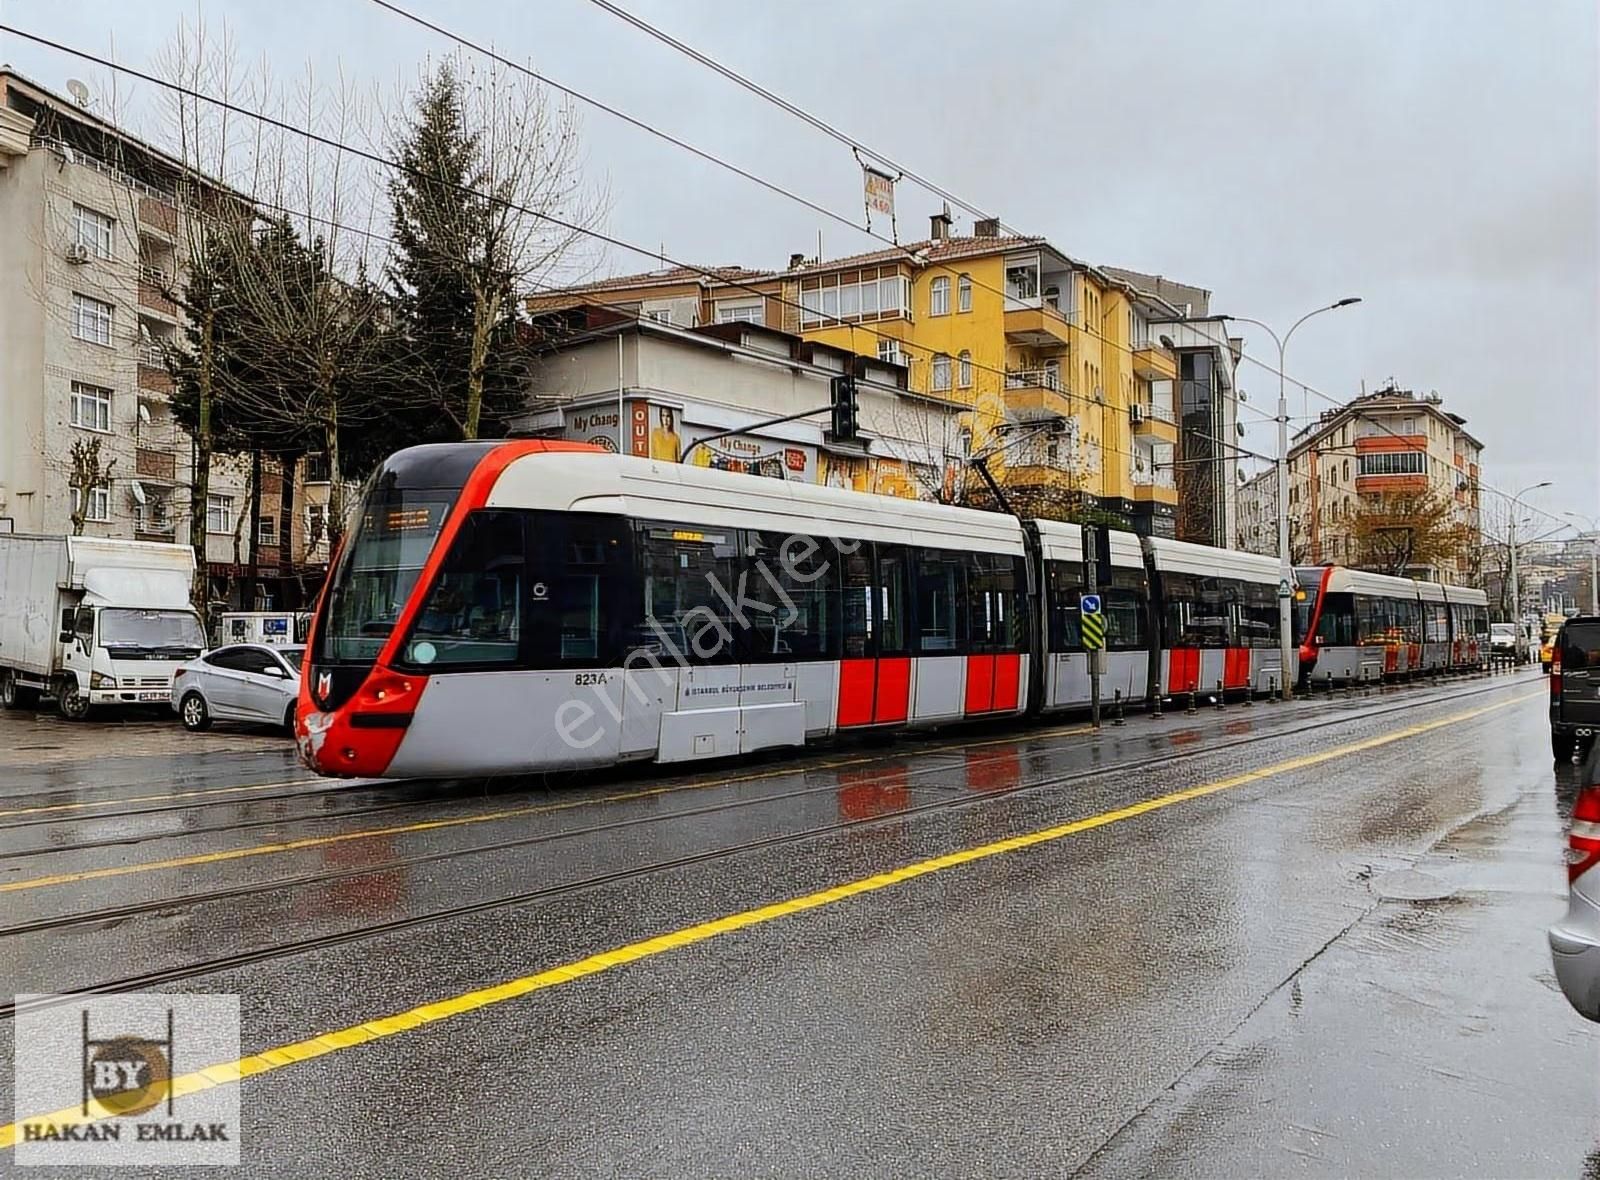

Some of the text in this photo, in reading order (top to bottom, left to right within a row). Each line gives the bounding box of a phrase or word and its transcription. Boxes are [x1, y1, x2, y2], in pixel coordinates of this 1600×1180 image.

[574, 412, 619, 432] My Chang
[575, 672, 608, 686] 823A
